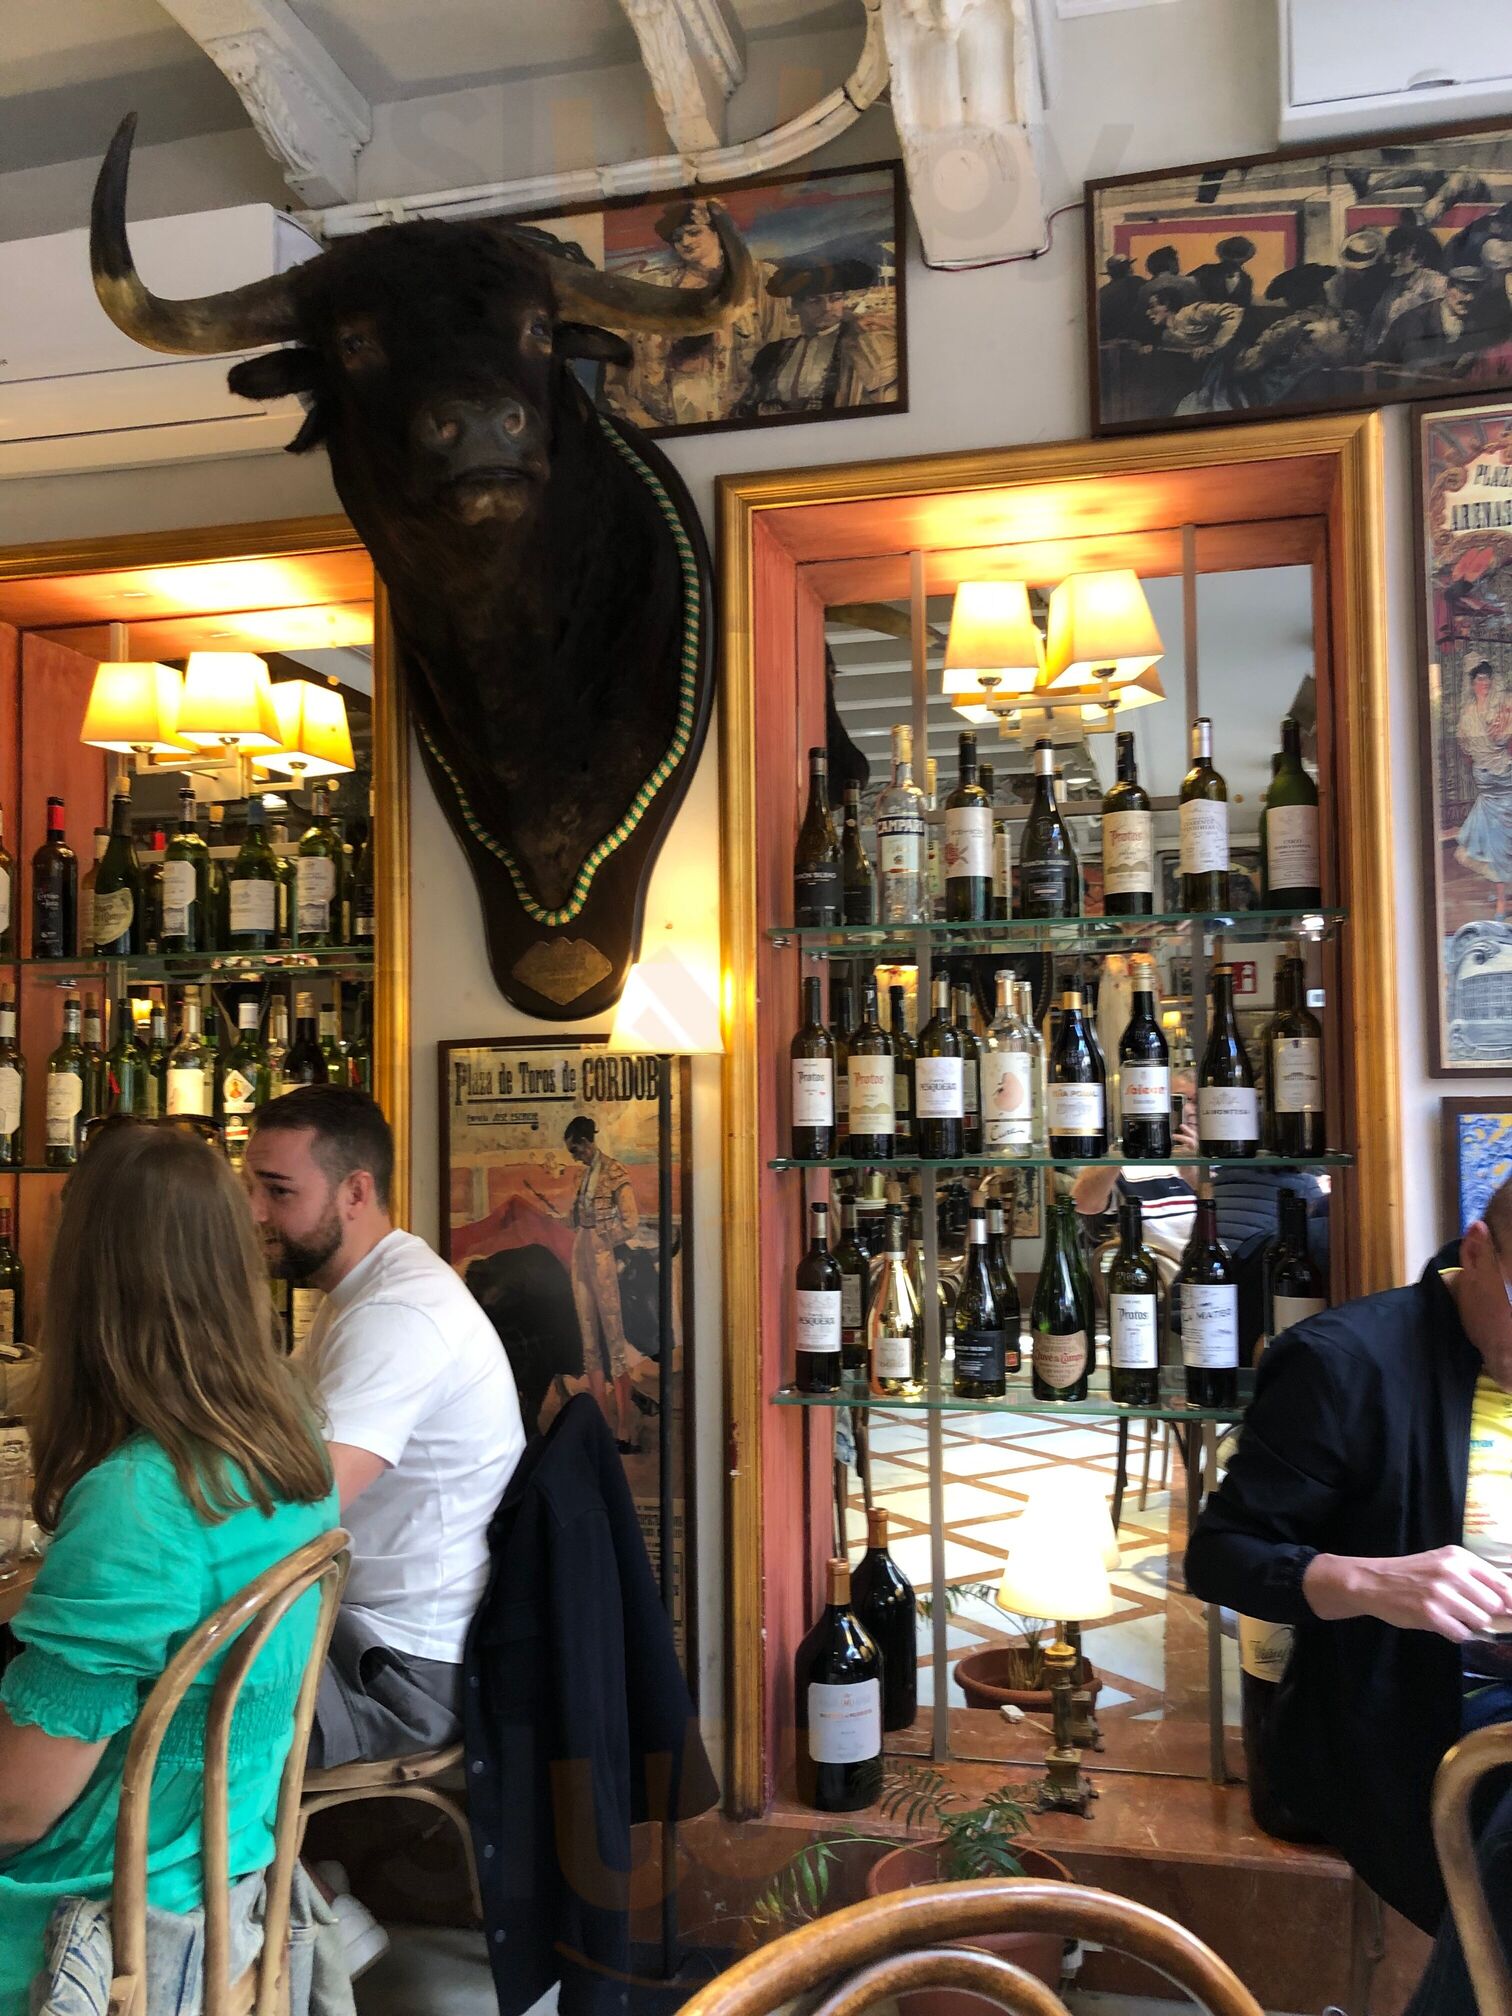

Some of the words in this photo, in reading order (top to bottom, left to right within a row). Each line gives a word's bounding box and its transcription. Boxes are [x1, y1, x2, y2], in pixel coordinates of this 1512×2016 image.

[454, 1061, 493, 1106] Plaza
[499, 1063, 513, 1096] de
[518, 1061, 555, 1095] Toros
[562, 1060, 577, 1093] de
[582, 1055, 673, 1102] CORDOB
[1117, 1307, 1148, 1322] Protos
